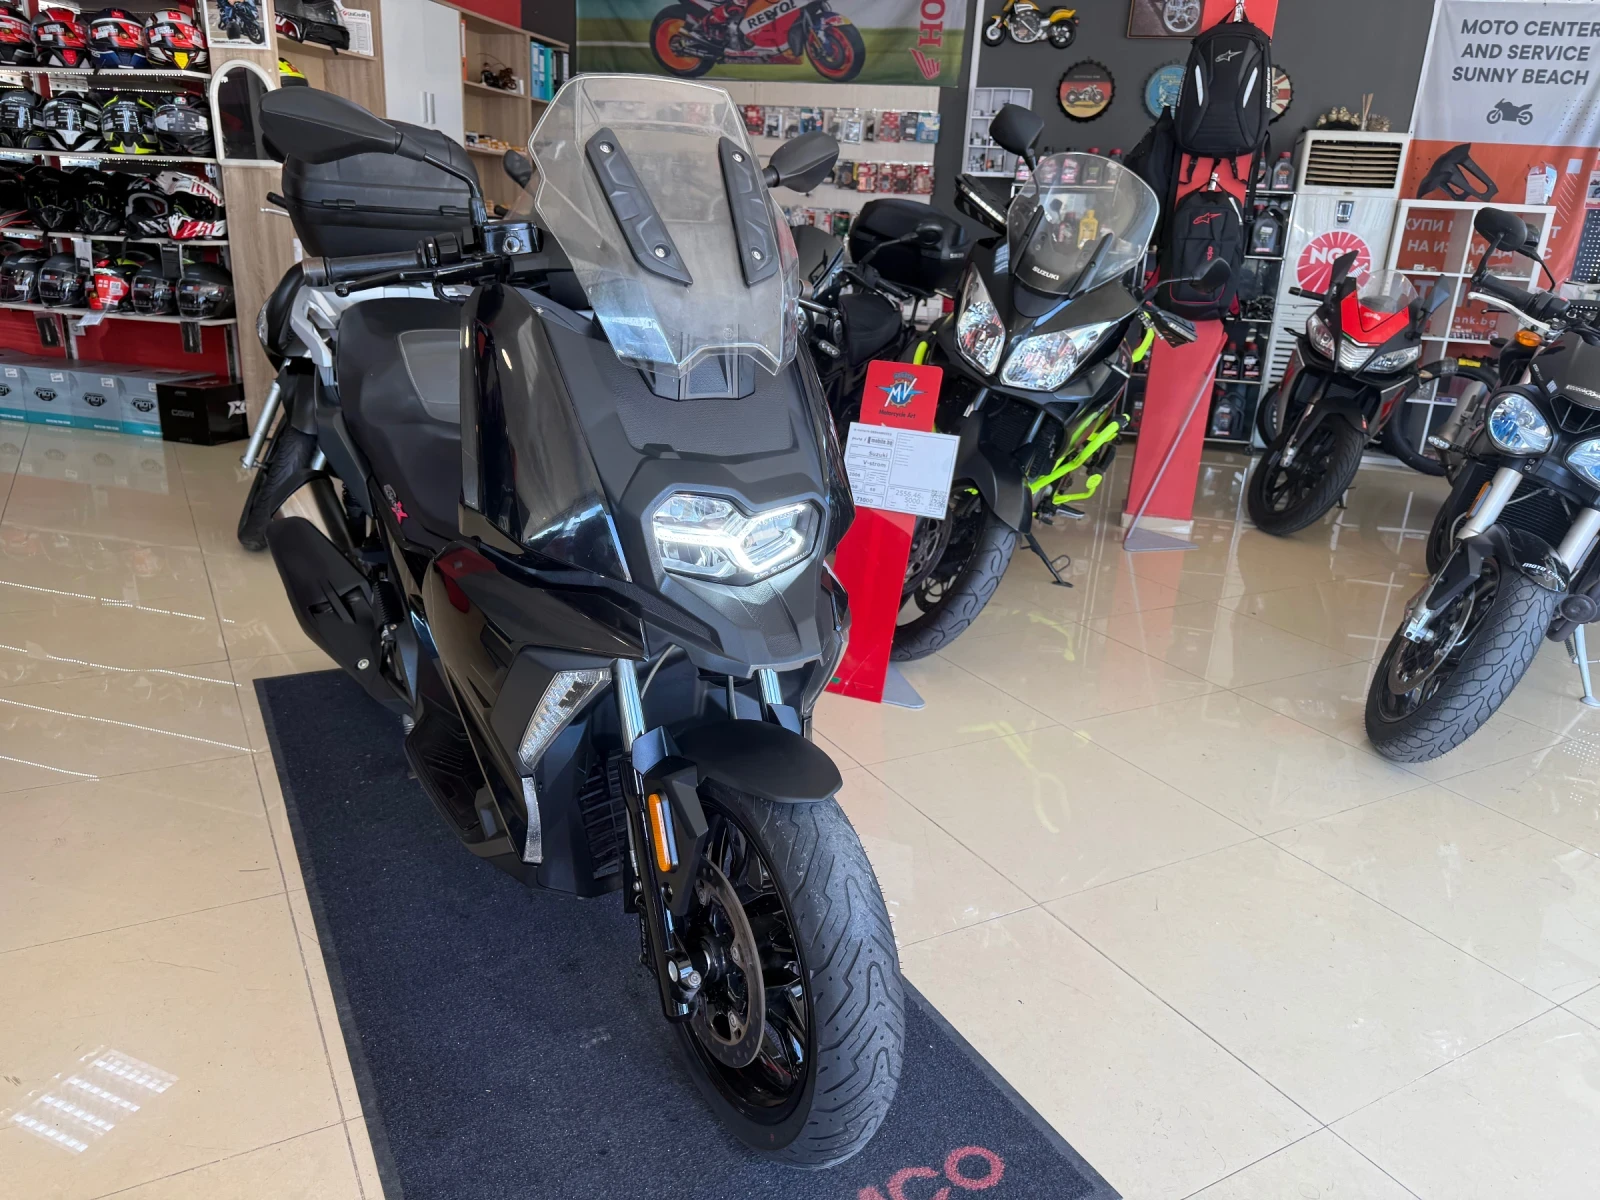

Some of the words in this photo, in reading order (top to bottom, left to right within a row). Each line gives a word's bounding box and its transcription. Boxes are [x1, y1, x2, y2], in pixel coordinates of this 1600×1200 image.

[1461, 19, 1519, 35] MOTO
[1523, 20, 1600, 37] CENTER
[1461, 43, 1503, 59] AND
[1507, 44, 1591, 62] SERVICE
[1451, 66, 1519, 83] SUNNY
[1521, 68, 1590, 85] BEACH
[1032, 265, 1060, 280] SUZUKI
[884, 377, 918, 407] MV
[863, 460, 887, 468] V-strom
